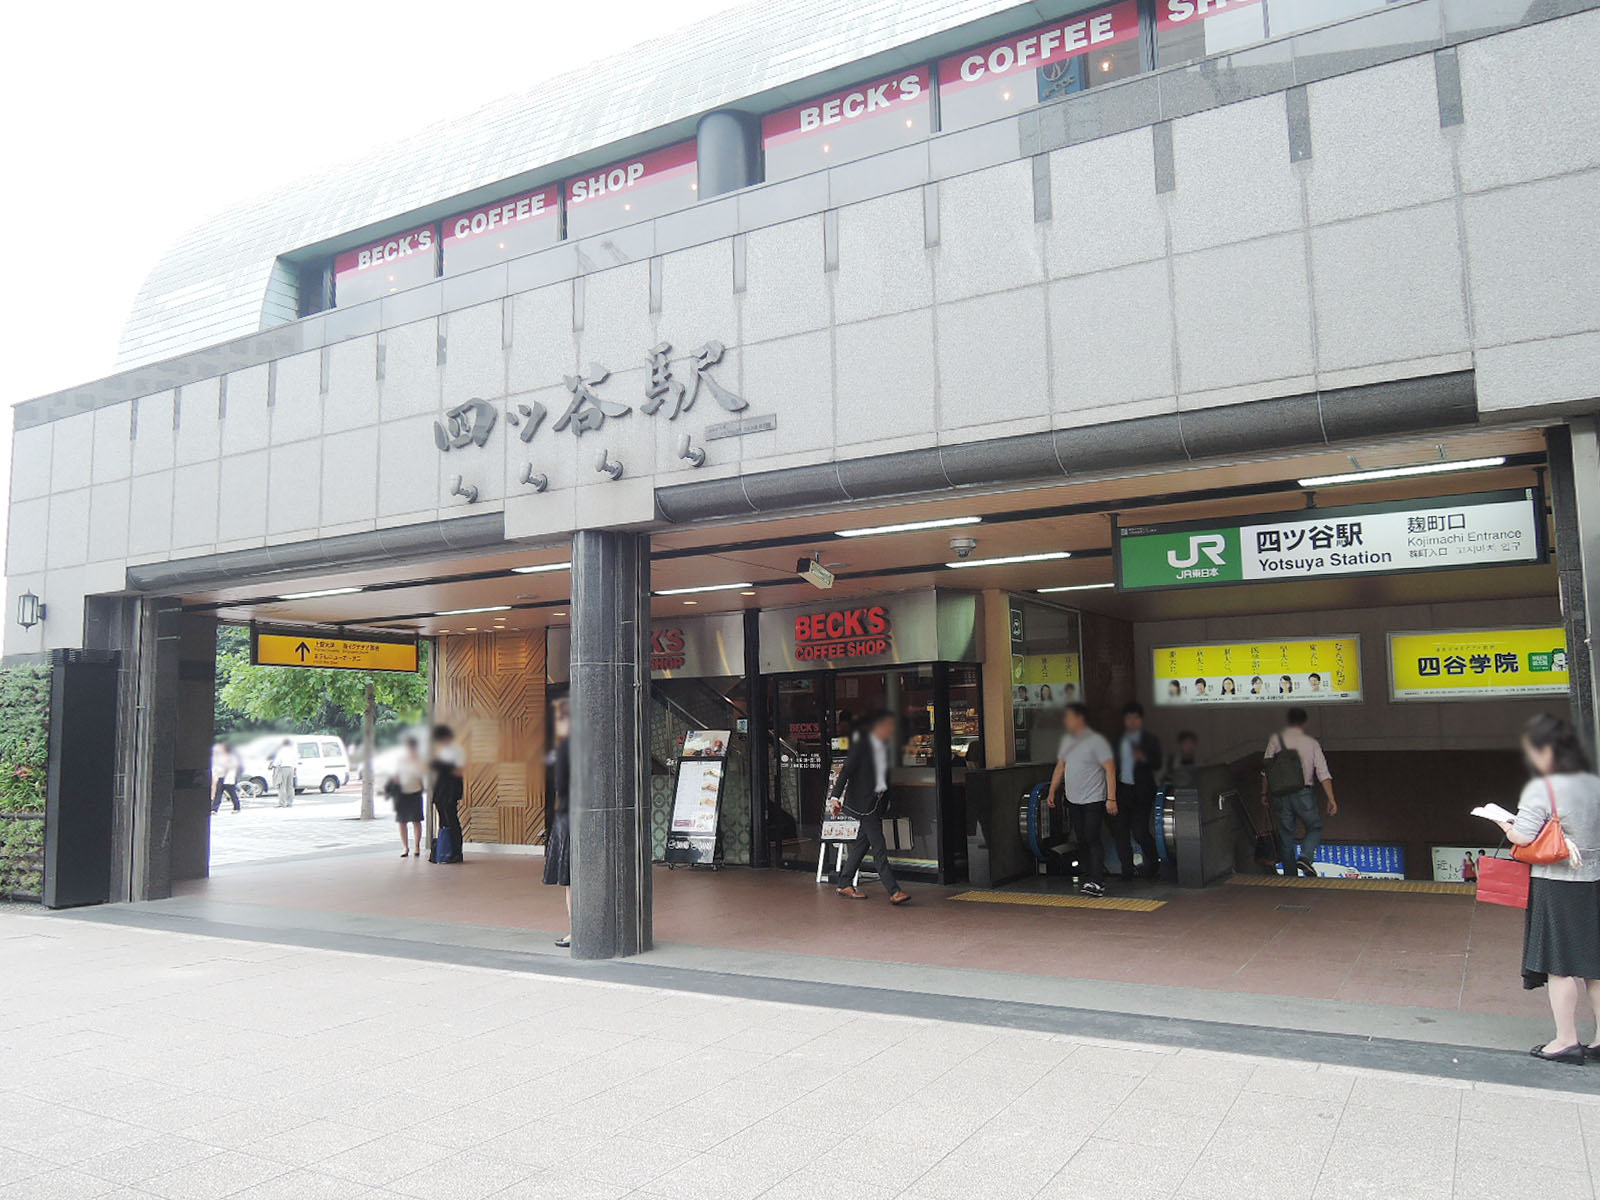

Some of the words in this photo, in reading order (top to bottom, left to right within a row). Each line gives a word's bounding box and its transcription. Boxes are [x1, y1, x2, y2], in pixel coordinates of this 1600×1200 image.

[800, 75, 920, 132] BECK'S
[960, 13, 1115, 82] COFFEE
[358, 230, 432, 270] BECK'S
[454, 194, 546, 239] COFFEE
[572, 163, 645, 203] SHOP
[1167, 534, 1227, 568] JR
[1256, 522, 1364, 553] 四ツ谷駅
[1407, 533, 1464, 548] Kojimachi
[1468, 530, 1522, 542] Entrance
[1176, 568, 1220, 580] JR東日本
[1259, 557, 1324, 572] Yotsuya
[1330, 552, 1392, 567] Station
[795, 607, 885, 641] BECK'S
[795, 644, 845, 661] COFFEE
[848, 640, 885, 656] SHOP
[1418, 652, 1519, 677] 四谷学院
